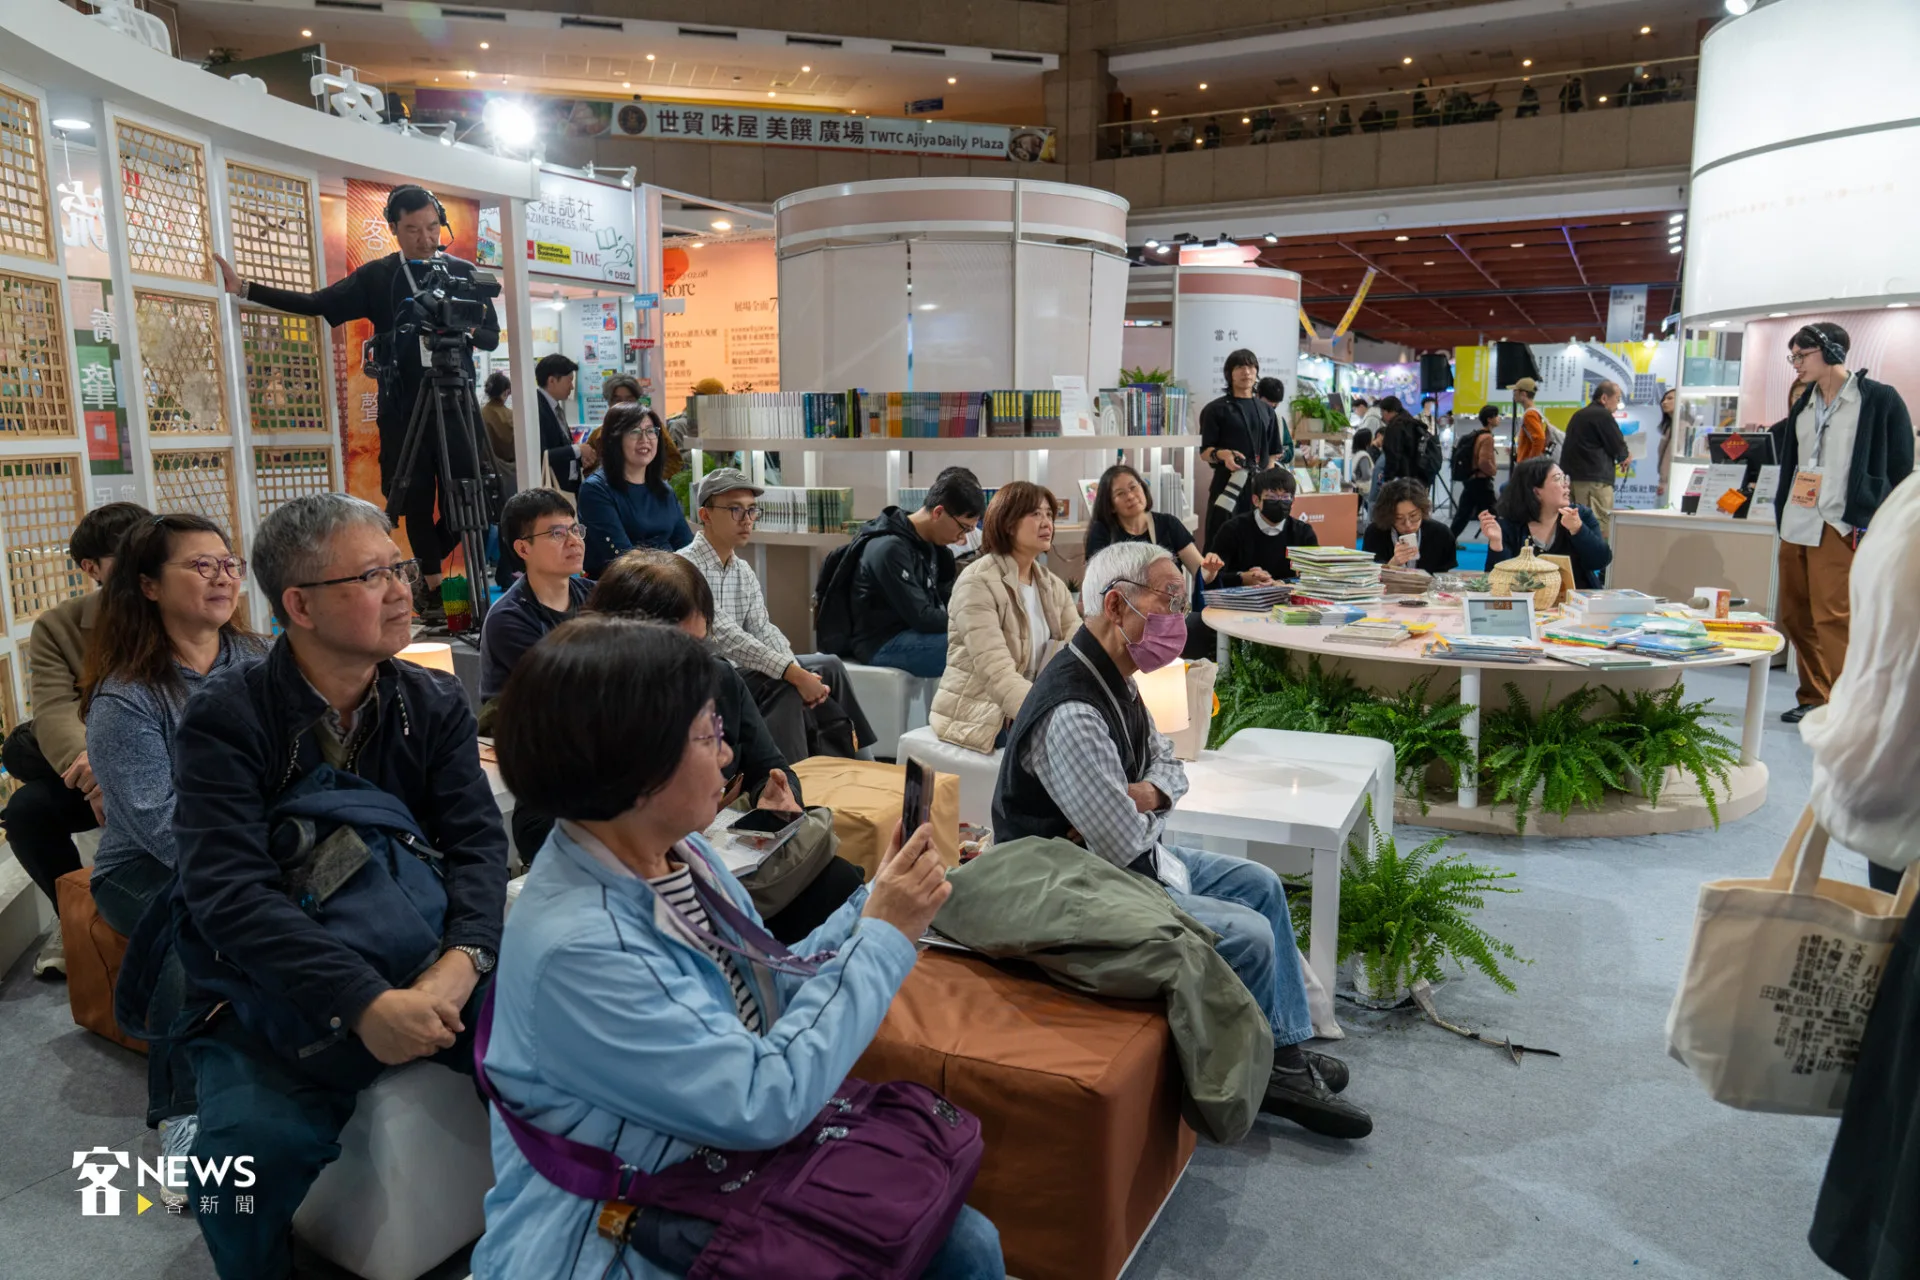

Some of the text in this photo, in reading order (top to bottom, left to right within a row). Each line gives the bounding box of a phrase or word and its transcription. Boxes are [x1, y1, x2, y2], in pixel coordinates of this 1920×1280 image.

[870, 131, 904, 144] TWTC
[906, 133, 936, 147] Ajiya
[938, 135, 968, 150] Daily
[972, 137, 1004, 150] Plaza
[573, 249, 602, 267] TIME
[614, 270, 631, 281] D522
[1213, 329, 1239, 342] 當代
